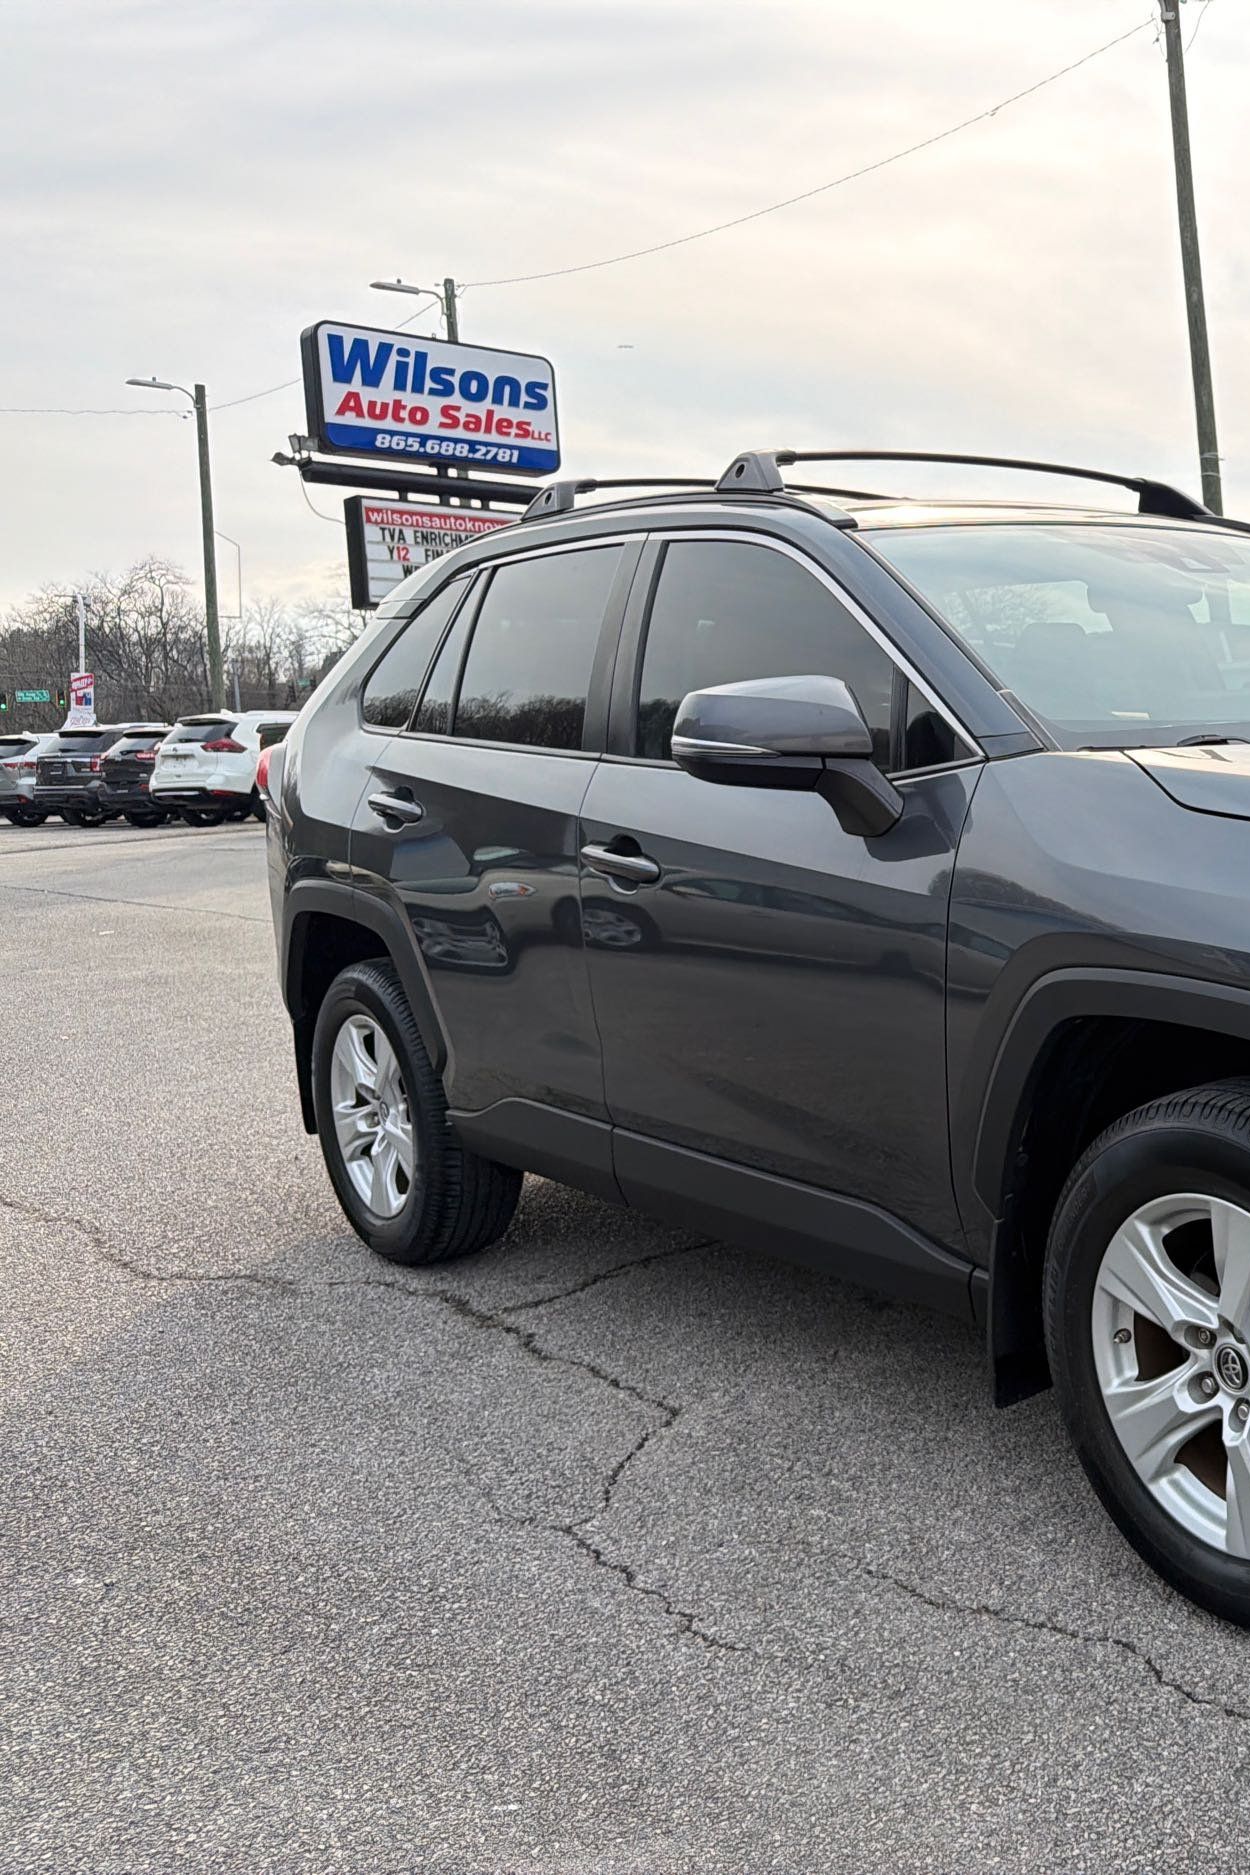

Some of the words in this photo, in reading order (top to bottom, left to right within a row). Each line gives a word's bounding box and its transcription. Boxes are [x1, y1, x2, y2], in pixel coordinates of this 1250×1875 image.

[327, 333, 550, 411] Wilsons
[335, 391, 430, 426] Auto
[439, 404, 533, 440] Sales
[531, 427, 552, 443] LLC
[375, 433, 519, 463] 865.688.2781
[379, 526, 406, 544] TVA
[414, 530, 475, 547] ENRICHM
[388, 545, 410, 562] Y12
[424, 547, 451, 564] FIN
